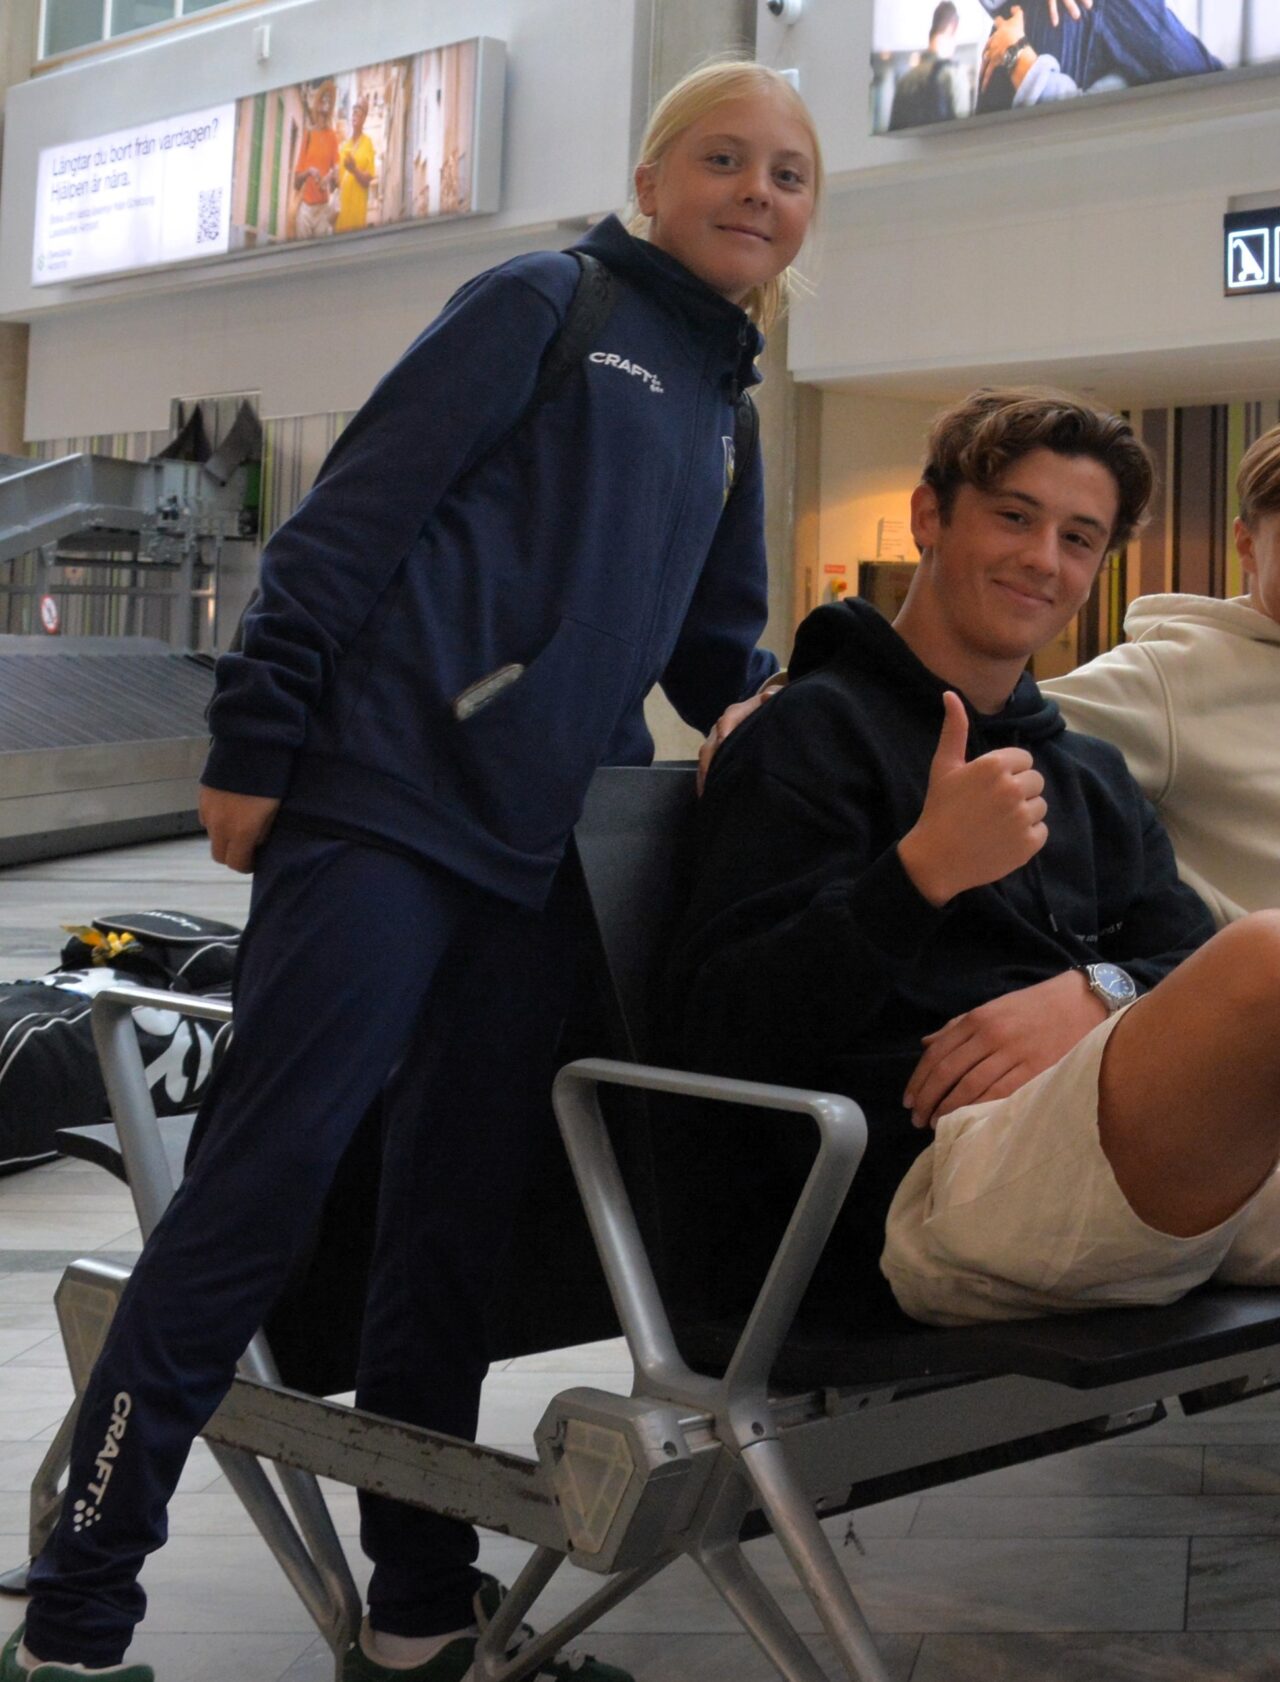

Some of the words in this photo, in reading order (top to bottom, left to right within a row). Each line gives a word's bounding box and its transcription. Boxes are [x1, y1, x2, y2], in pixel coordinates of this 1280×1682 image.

[52, 154, 92, 176] Längtar
[94, 149, 106, 166] du
[110, 141, 132, 163] bort
[159, 117, 219, 149] vardagen?
[588, 352, 654, 384] CRAFT
[87, 1391, 132, 1506] CRAFT
